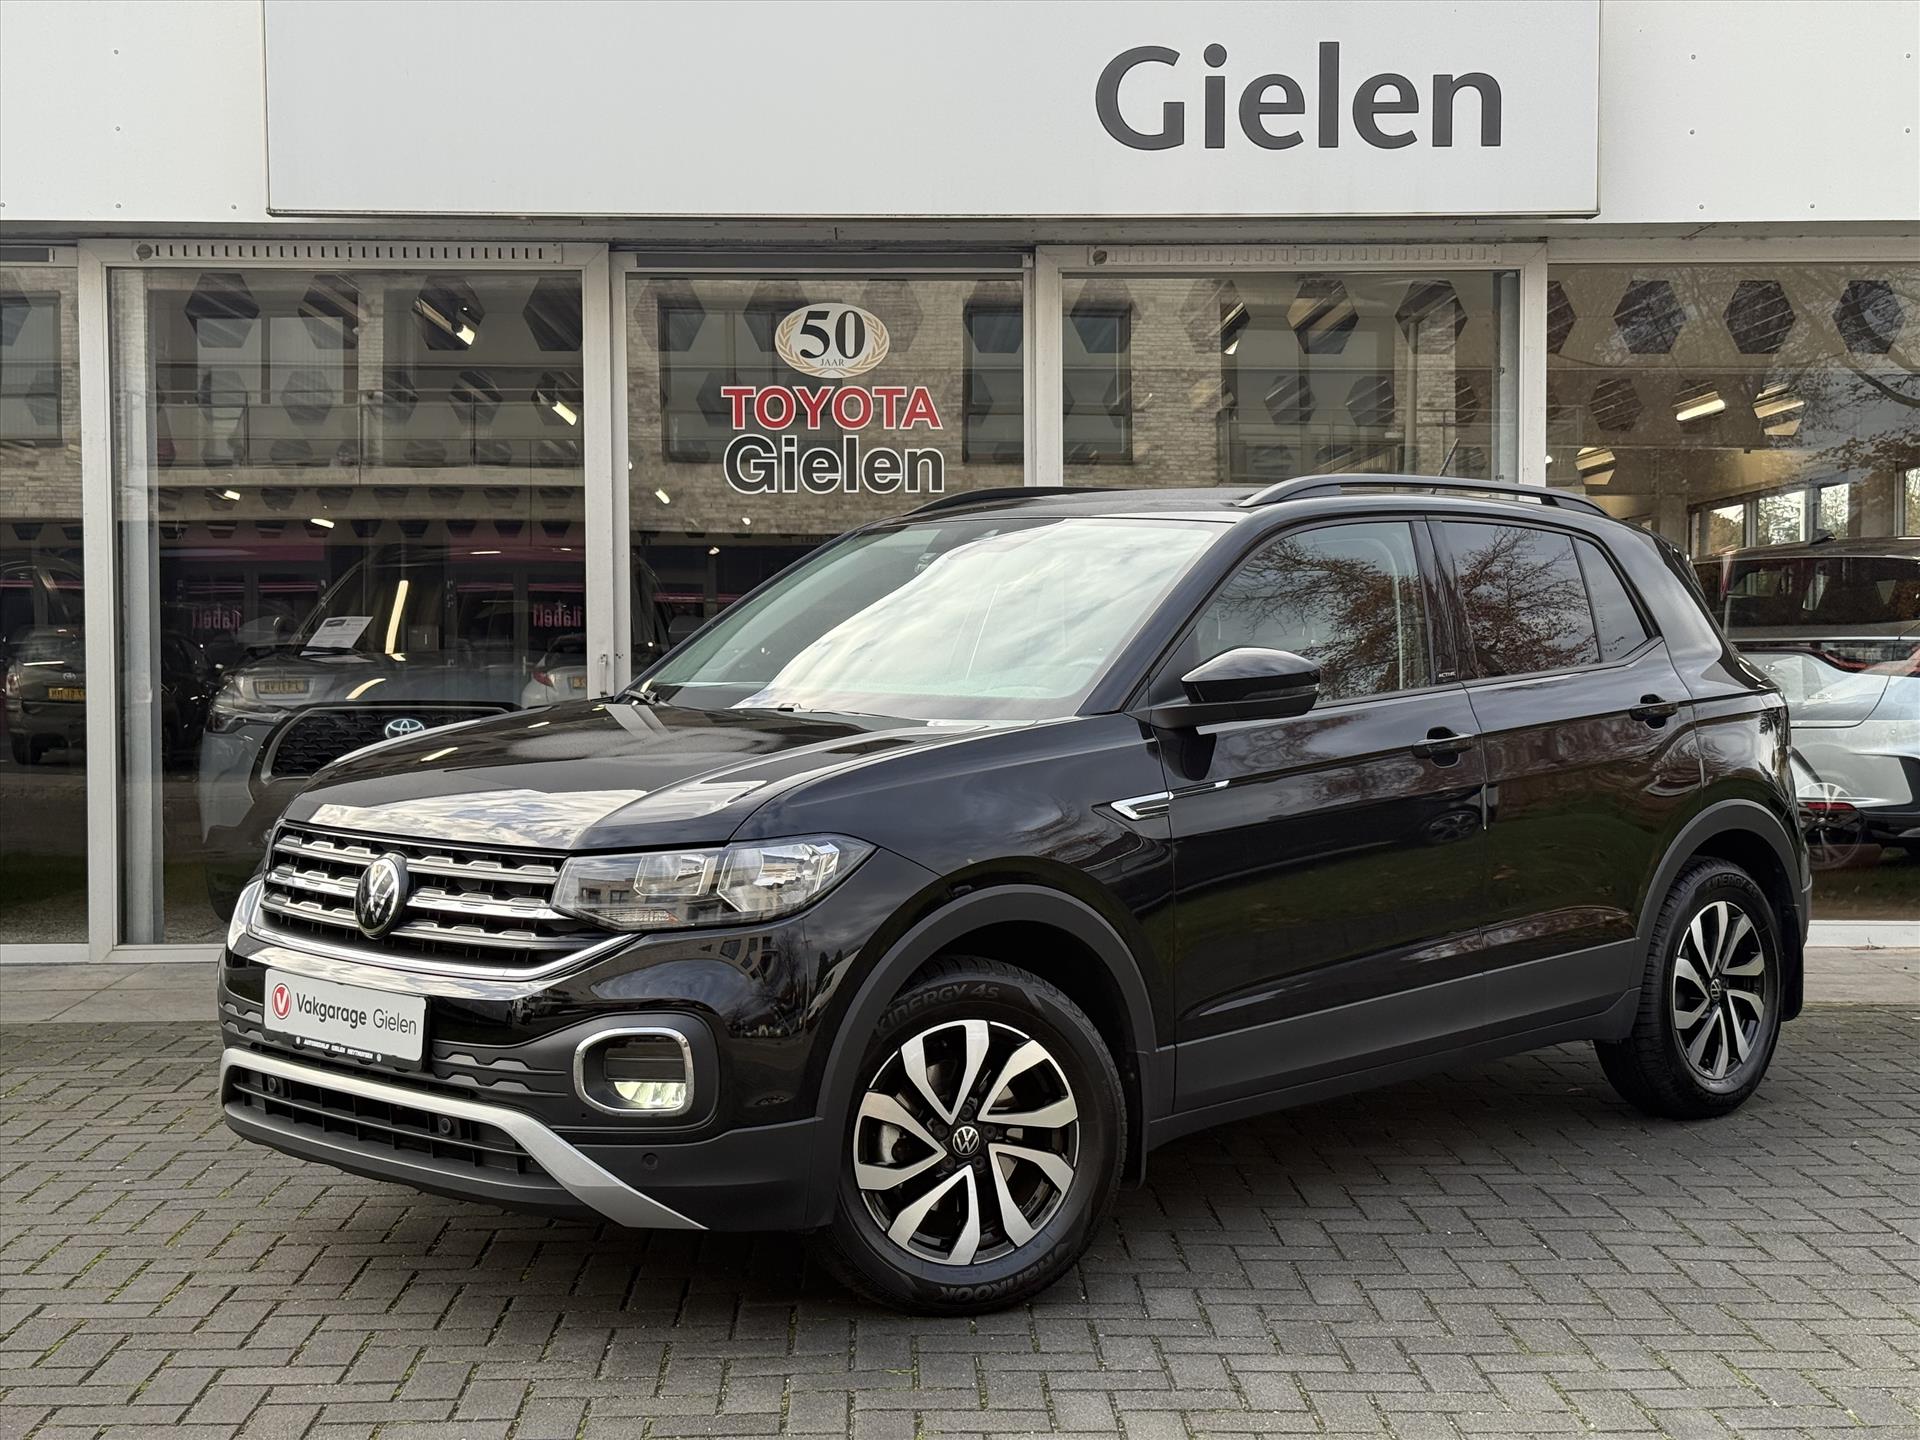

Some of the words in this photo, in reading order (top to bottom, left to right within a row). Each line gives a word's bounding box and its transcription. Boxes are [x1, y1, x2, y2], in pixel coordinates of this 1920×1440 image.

[1095, 41, 1502, 151] Gielen
[799, 310, 866, 360] 50
[820, 358, 845, 367] JAAR
[721, 385, 943, 431] TOYOTA
[723, 434, 945, 495] Gielen
[296, 992, 367, 1029] Vakgarage
[372, 1008, 418, 1036] Gielen
